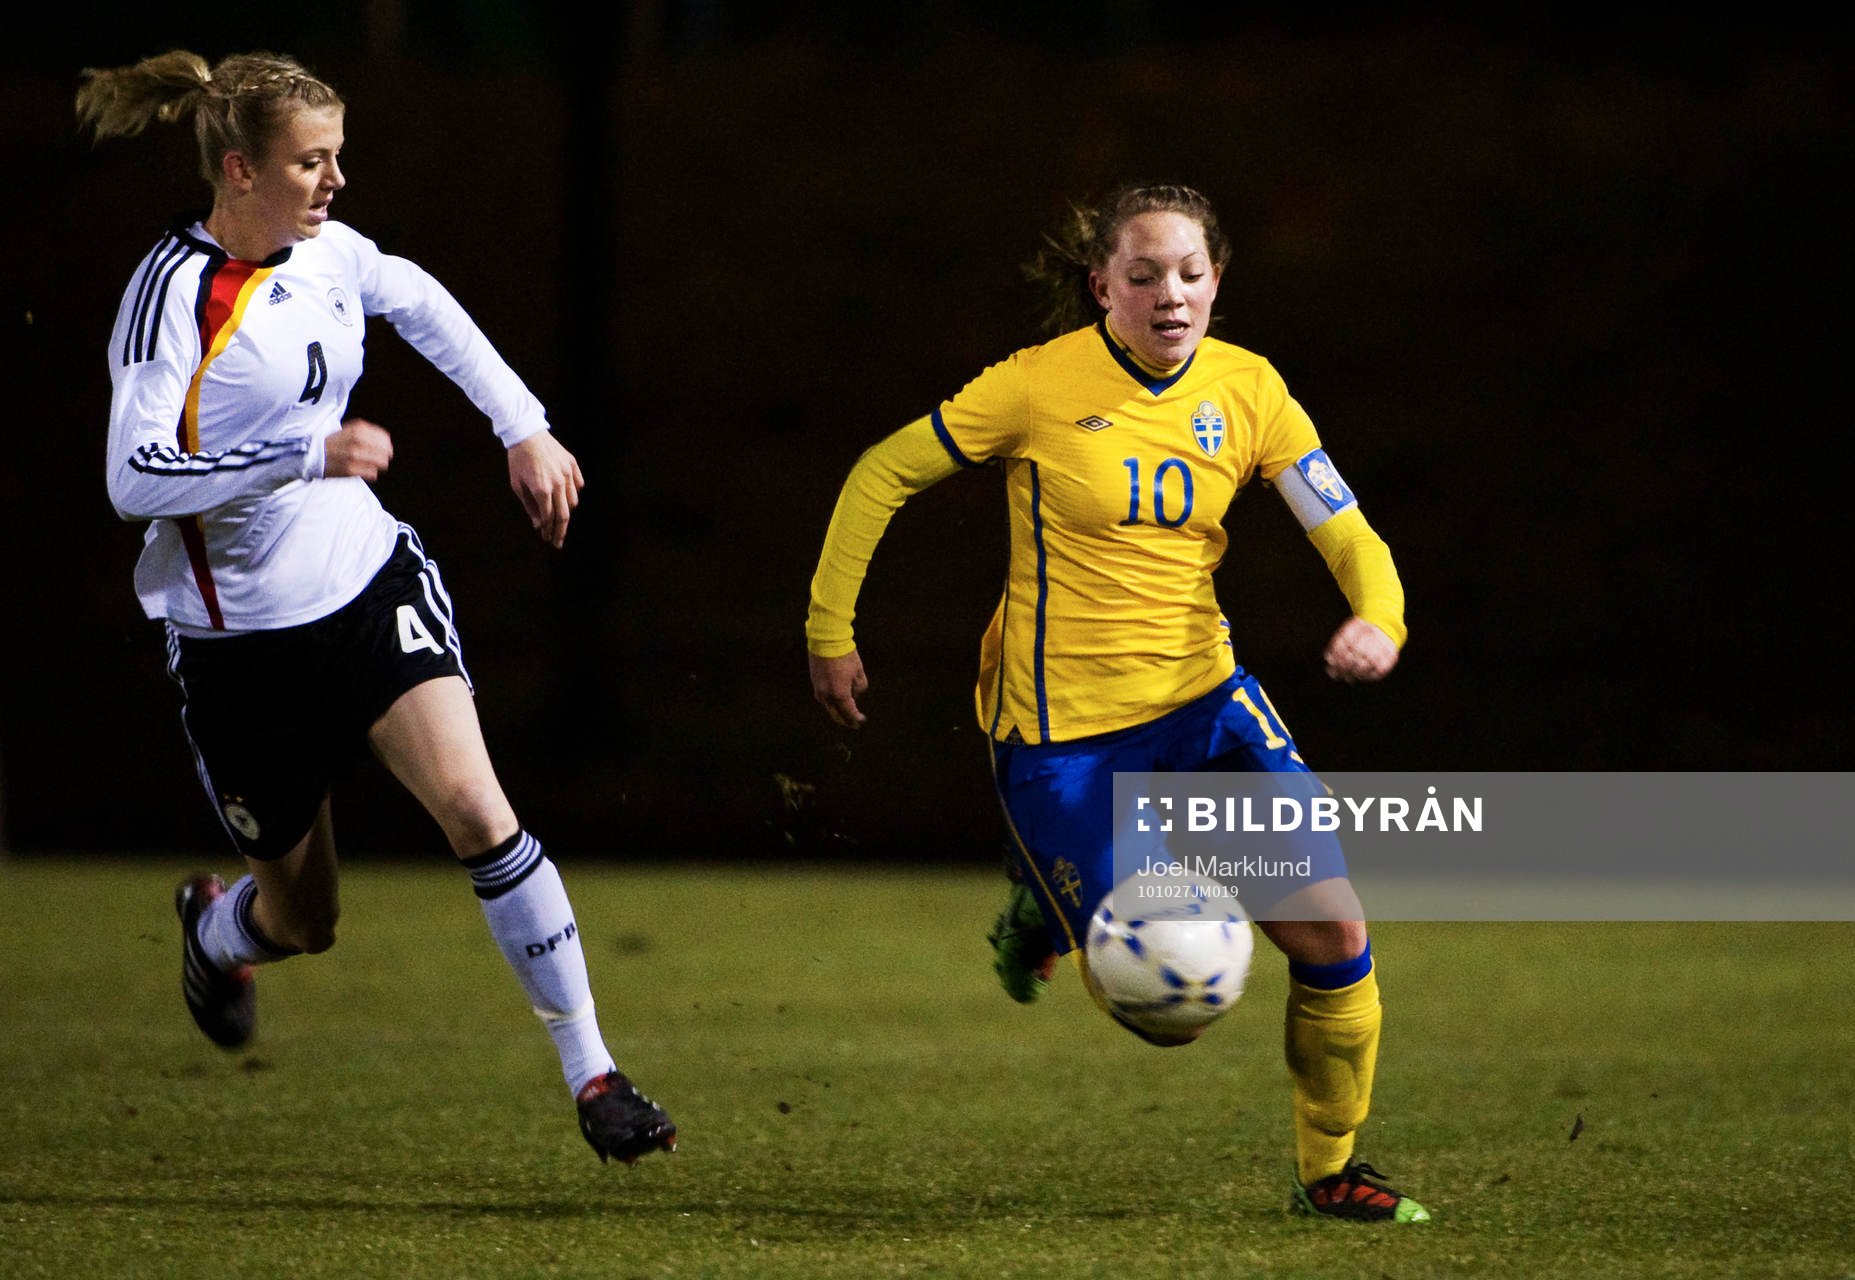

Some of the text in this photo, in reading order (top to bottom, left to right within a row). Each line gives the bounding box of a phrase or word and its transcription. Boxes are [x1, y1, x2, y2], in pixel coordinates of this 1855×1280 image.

[298, 341, 328, 405] 4
[1118, 457, 1194, 528] 10
[396, 604, 445, 655] 4
[1231, 685, 1293, 750] 1
